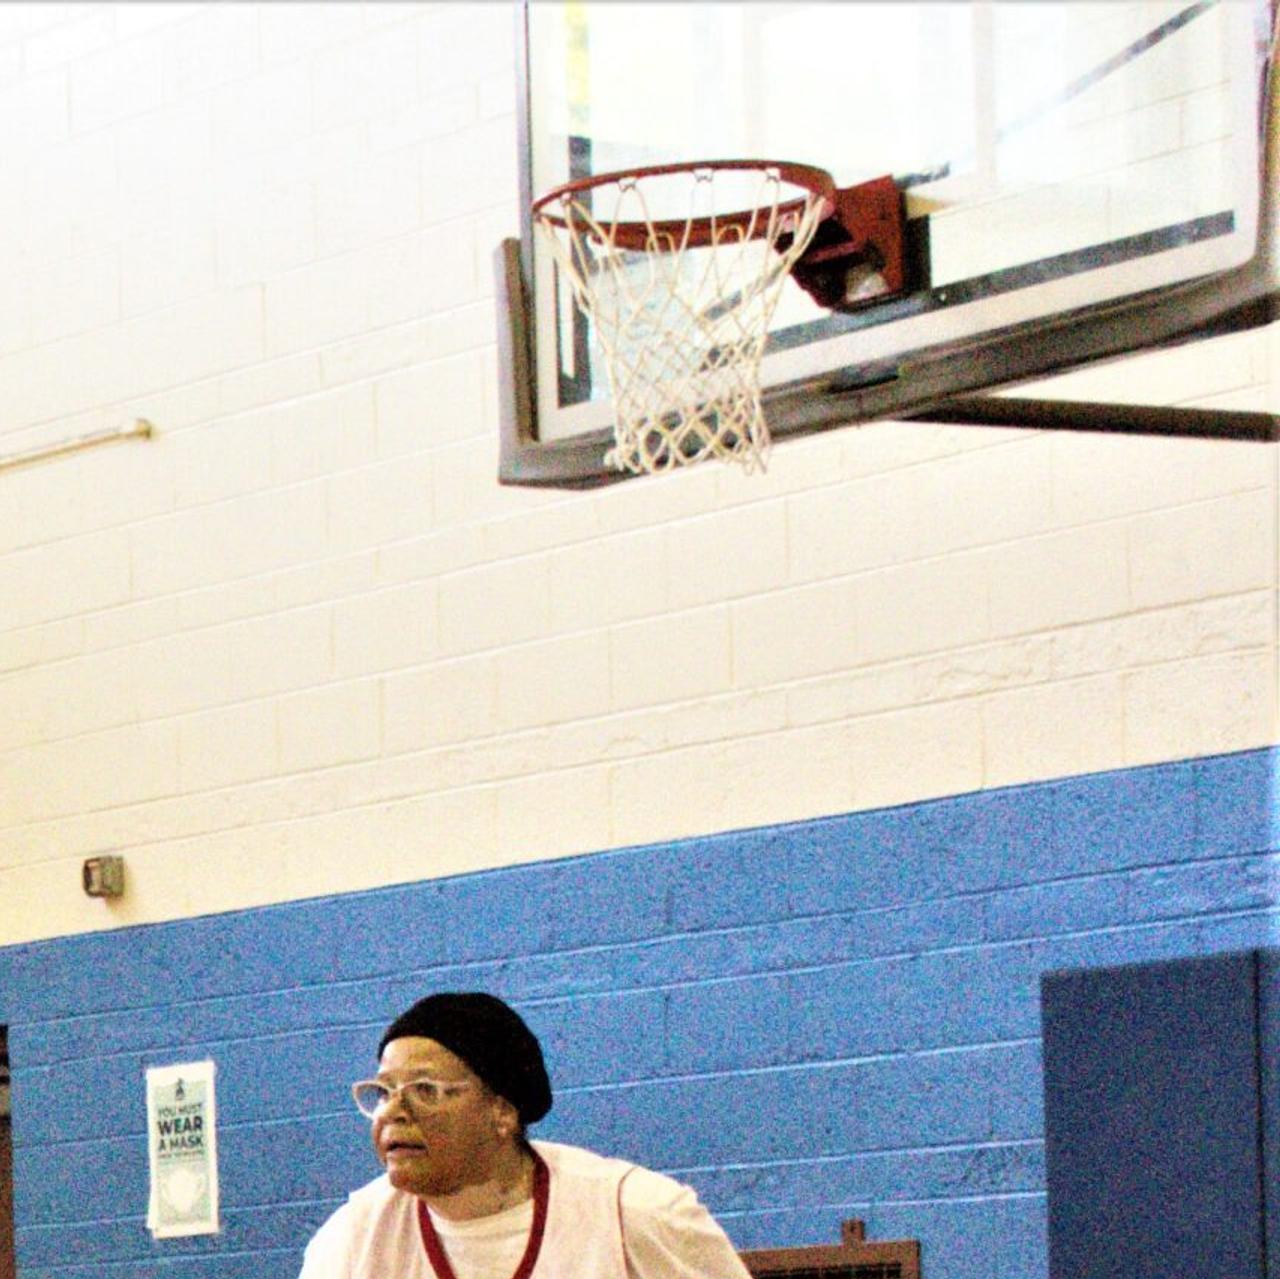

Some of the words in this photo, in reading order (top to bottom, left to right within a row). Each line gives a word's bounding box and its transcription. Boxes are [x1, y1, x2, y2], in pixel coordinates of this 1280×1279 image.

[157, 1115, 203, 1136] WEAR
[158, 1138, 166, 1151] A
[170, 1134, 204, 1150] MASK
